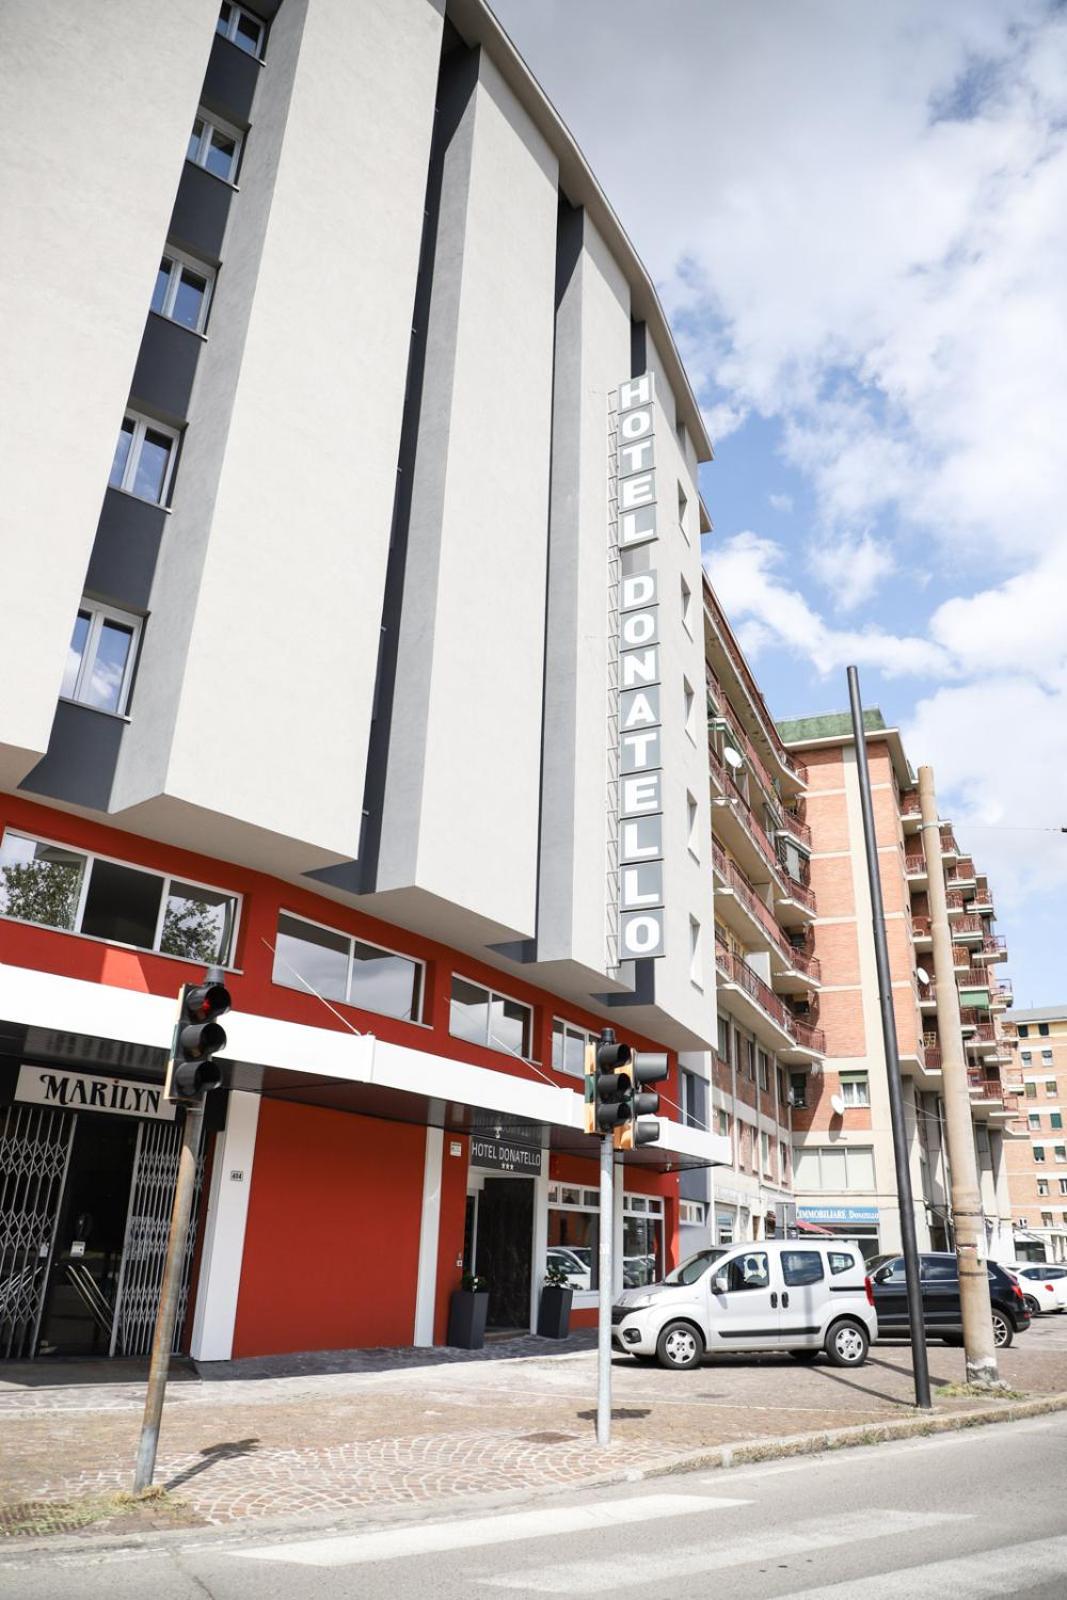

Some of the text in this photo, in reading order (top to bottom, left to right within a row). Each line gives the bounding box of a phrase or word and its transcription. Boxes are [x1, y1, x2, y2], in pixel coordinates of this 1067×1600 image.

[621, 376, 660, 953] HOTEL DONATELLO
[39, 1074, 161, 1114] MARILYN
[472, 1142, 498, 1160] HOTEL
[499, 1147, 541, 1167] DONATELLO
